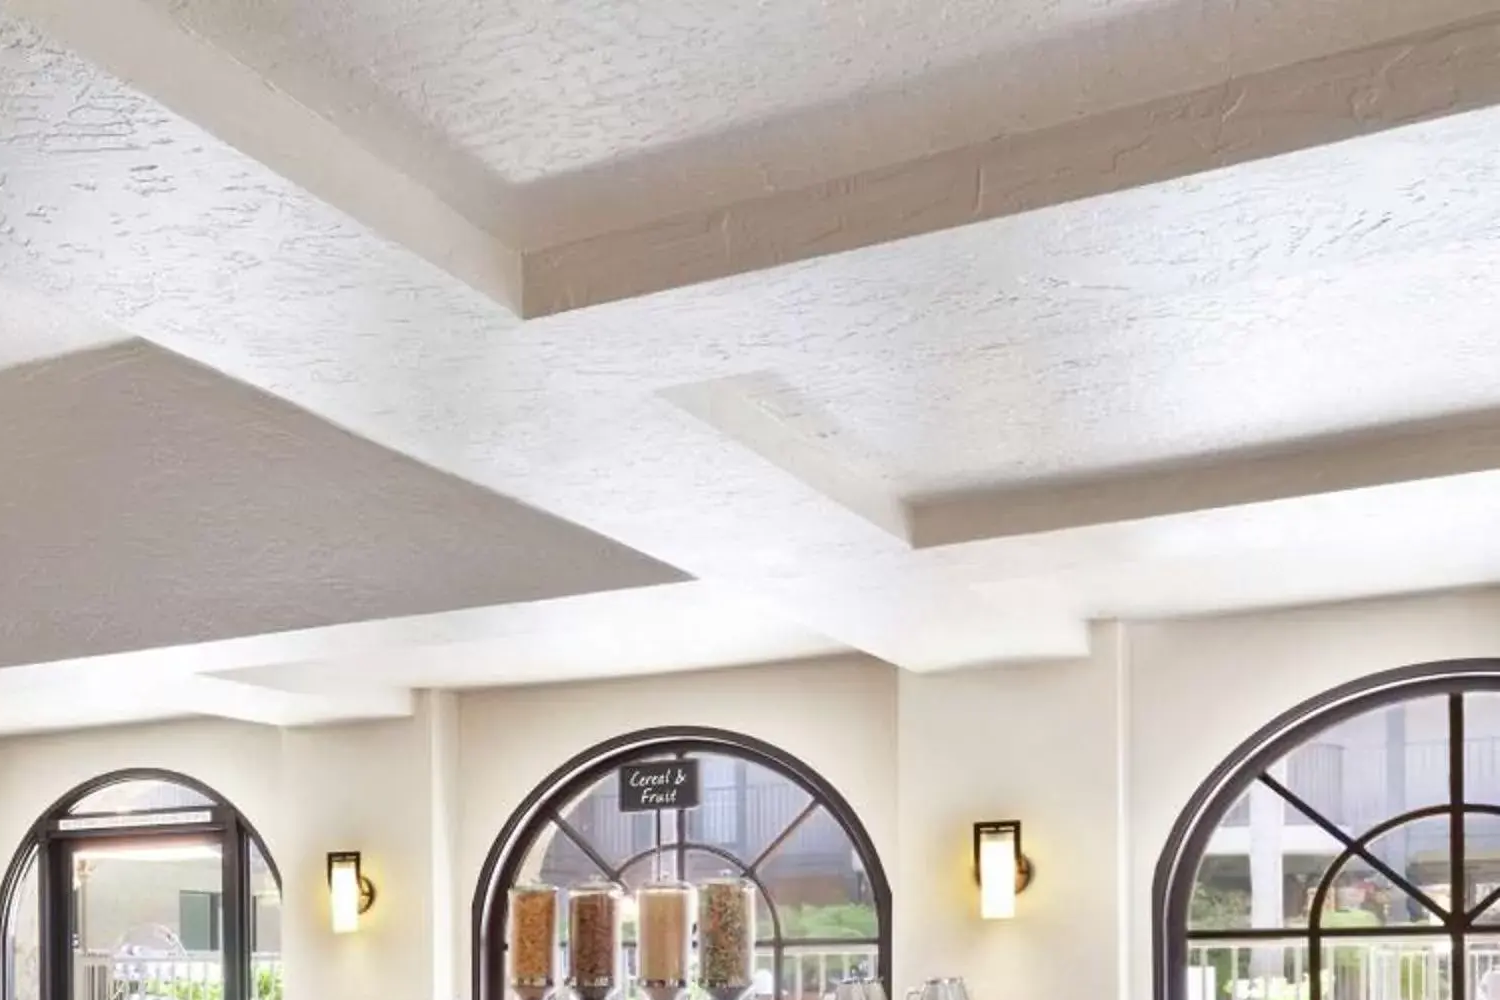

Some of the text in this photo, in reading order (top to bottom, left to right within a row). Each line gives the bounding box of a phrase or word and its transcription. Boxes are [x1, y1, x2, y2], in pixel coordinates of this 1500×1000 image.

[629, 768, 686, 787] Cereal &
[641, 788, 677, 804] Fruit
